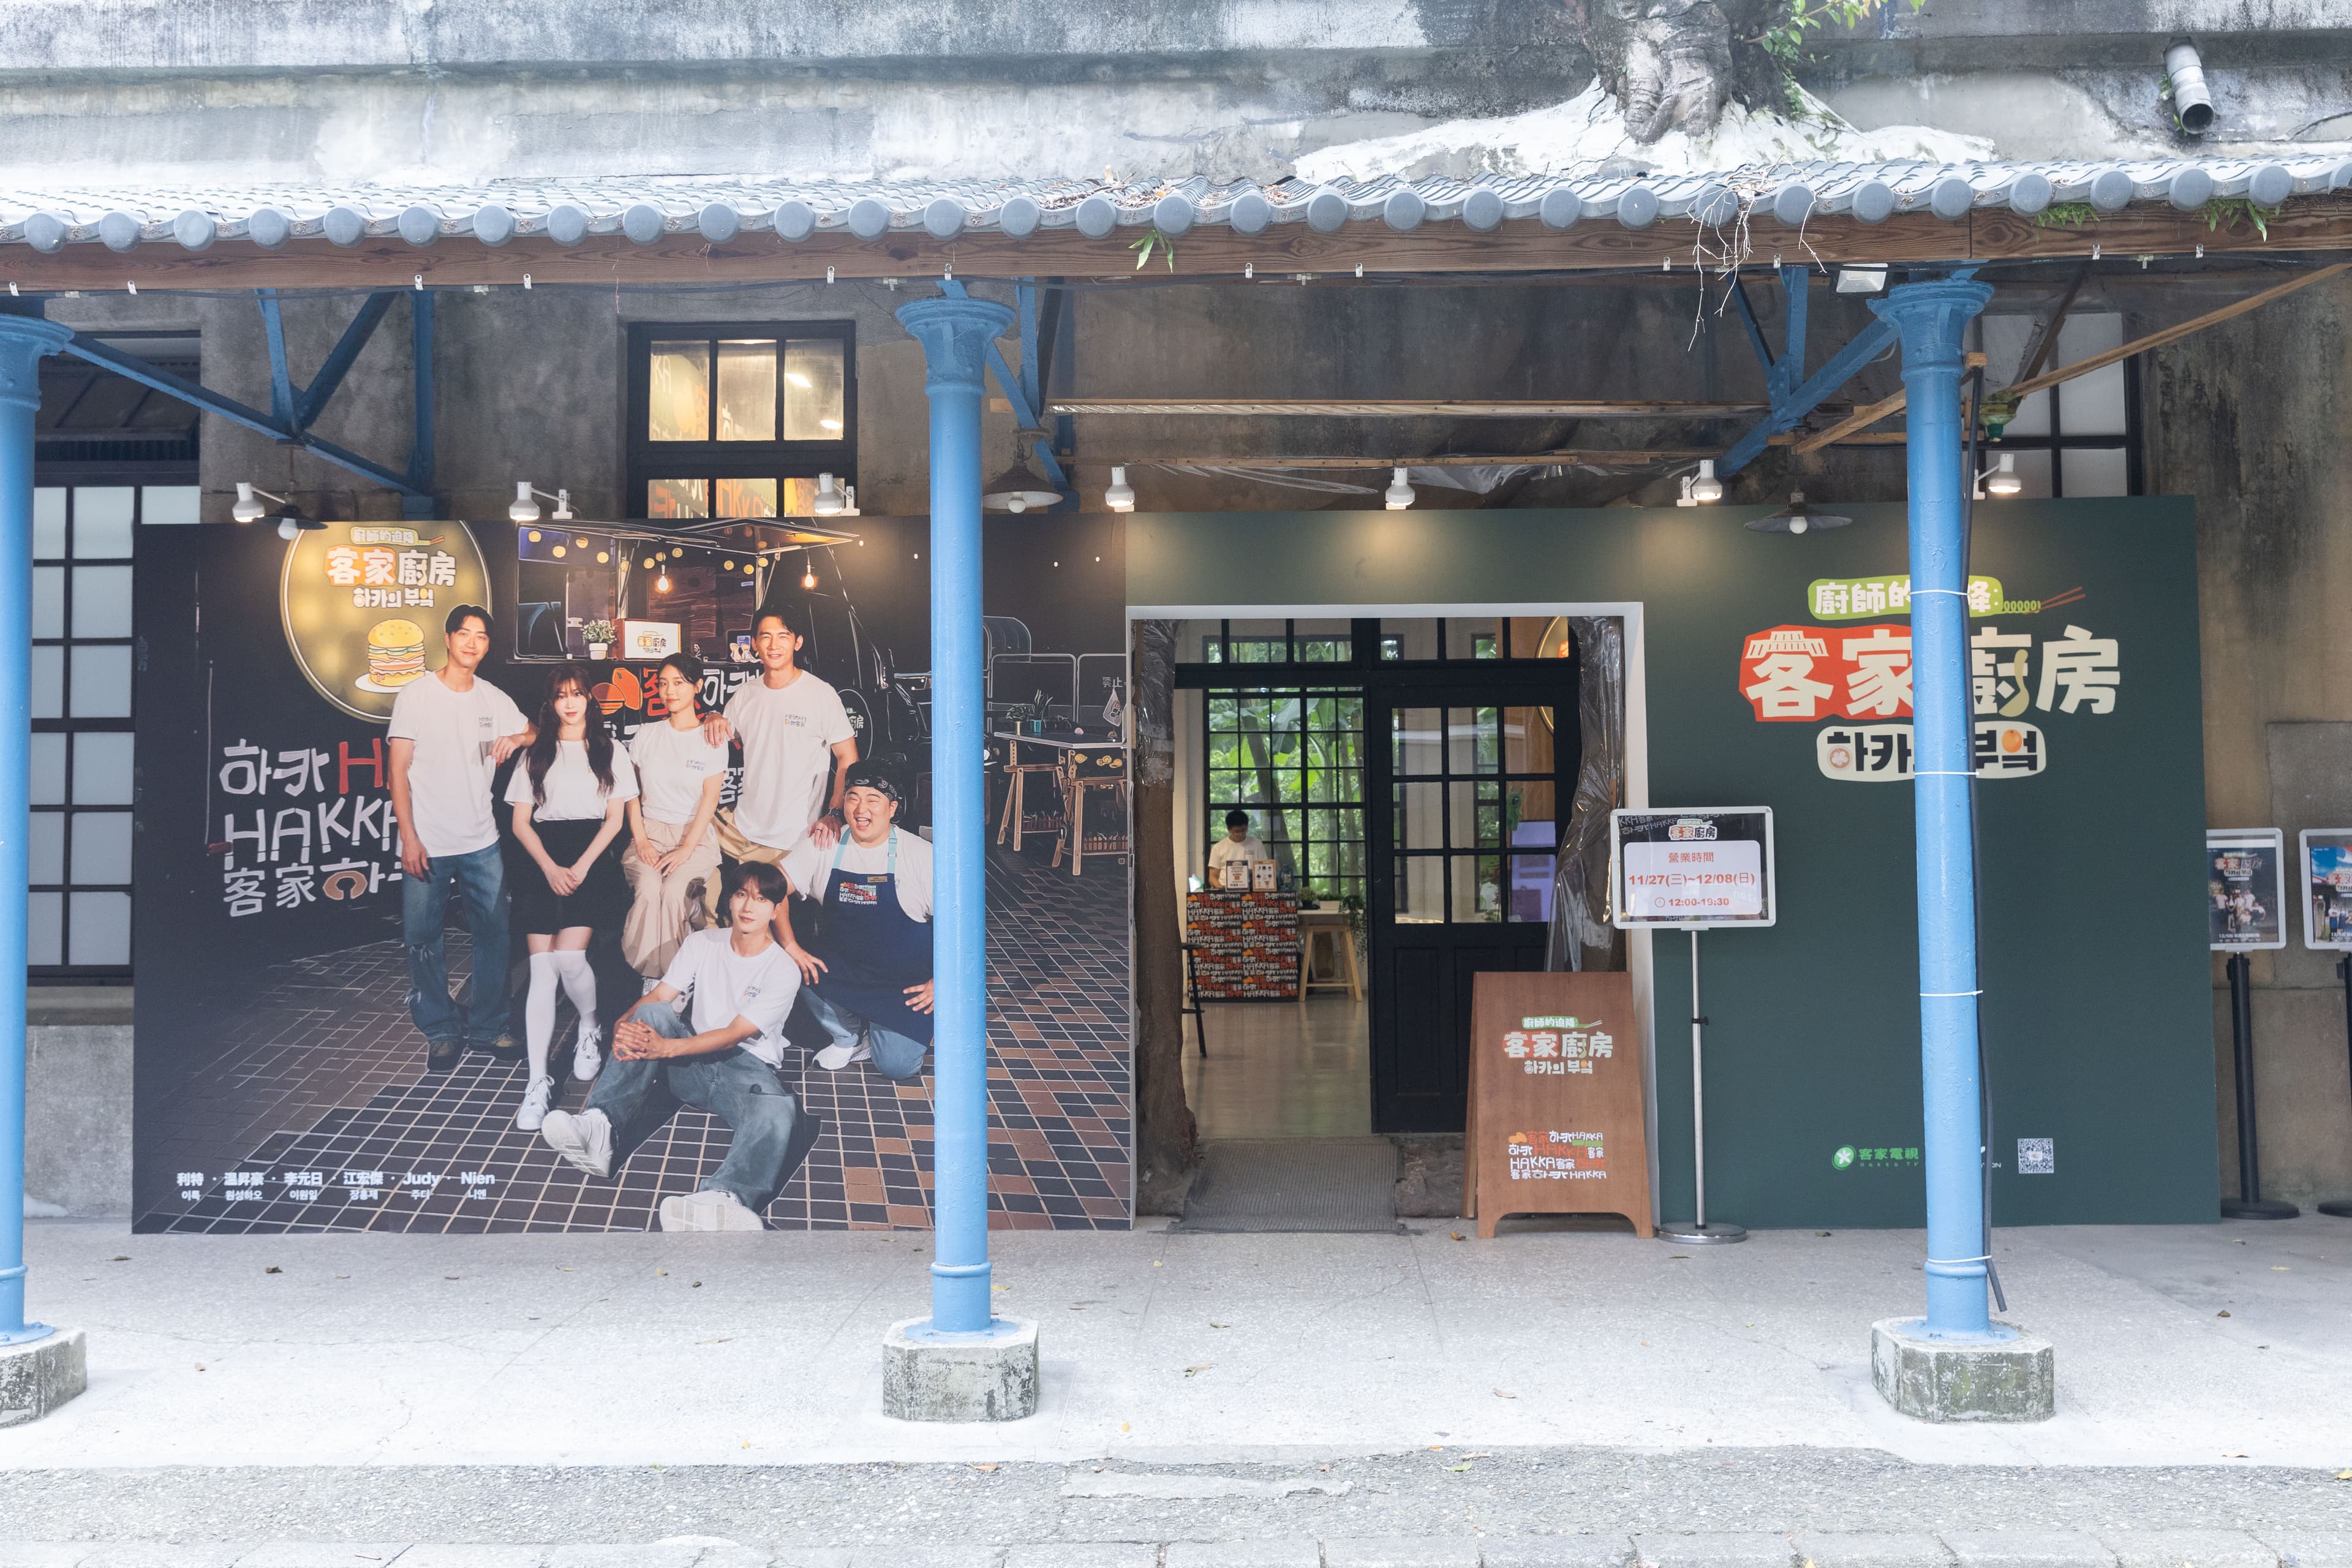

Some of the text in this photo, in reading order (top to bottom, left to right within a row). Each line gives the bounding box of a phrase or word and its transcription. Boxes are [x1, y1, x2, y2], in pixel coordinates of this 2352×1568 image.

[327, 547, 456, 586] 客家廚房
[353, 587, 402, 608] 하카의
[1815, 581, 1992, 615] 廚師的降
[1826, 731, 1916, 774] 하카
[1671, 826, 1716, 839] 客家廚房
[1668, 852, 1714, 863] 營業時間
[1629, 872, 1755, 887] 11/27(三)~12/08(日)
[224, 862, 317, 917] 客家
[1668, 897, 1730, 907] 12:00-19:30
[1504, 1031, 1613, 1058] 客家廚房
[1524, 1060, 1564, 1074] 하카의
[1572, 1131, 1604, 1140] HAKKA
[1859, 1147, 1919, 1160] 客家電視
[1510, 1156, 1556, 1170] HAKKA
[1556, 1158, 1575, 1170] 客家
[176, 1172, 205, 1186] 利特
[402, 1171, 442, 1187] Judy
[460, 1171, 496, 1185] Nien
[1570, 1170, 1607, 1180] HAKKA
[289, 1189, 318, 1201] 이원일
